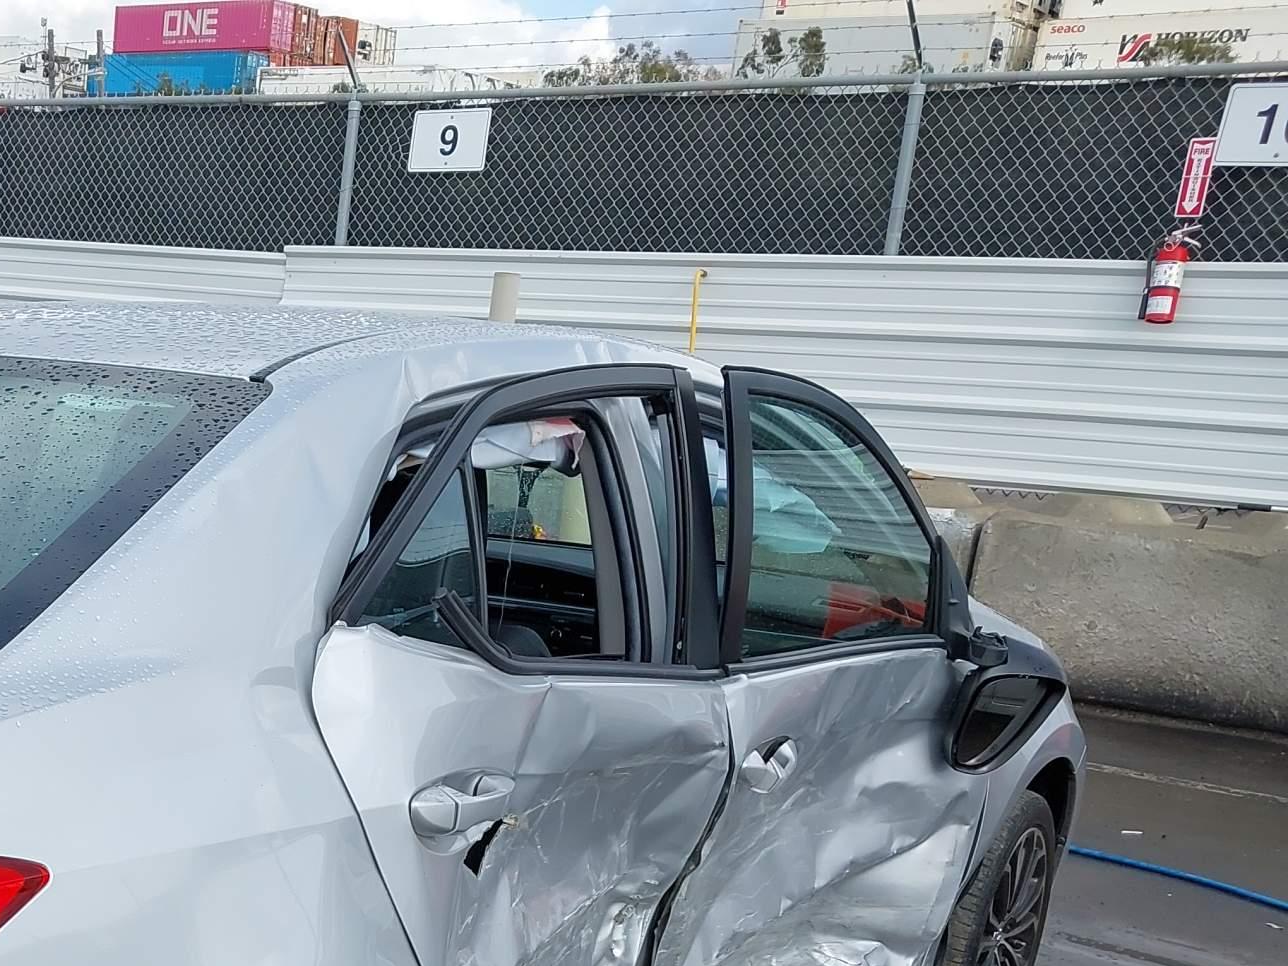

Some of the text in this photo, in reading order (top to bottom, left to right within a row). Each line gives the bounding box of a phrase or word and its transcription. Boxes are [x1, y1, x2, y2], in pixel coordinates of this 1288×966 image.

[163, 8, 218, 36] ONE
[1050, 24, 1086, 34] seaco
[1256, 104, 1288, 145] 1
[439, 125, 459, 156] 9
